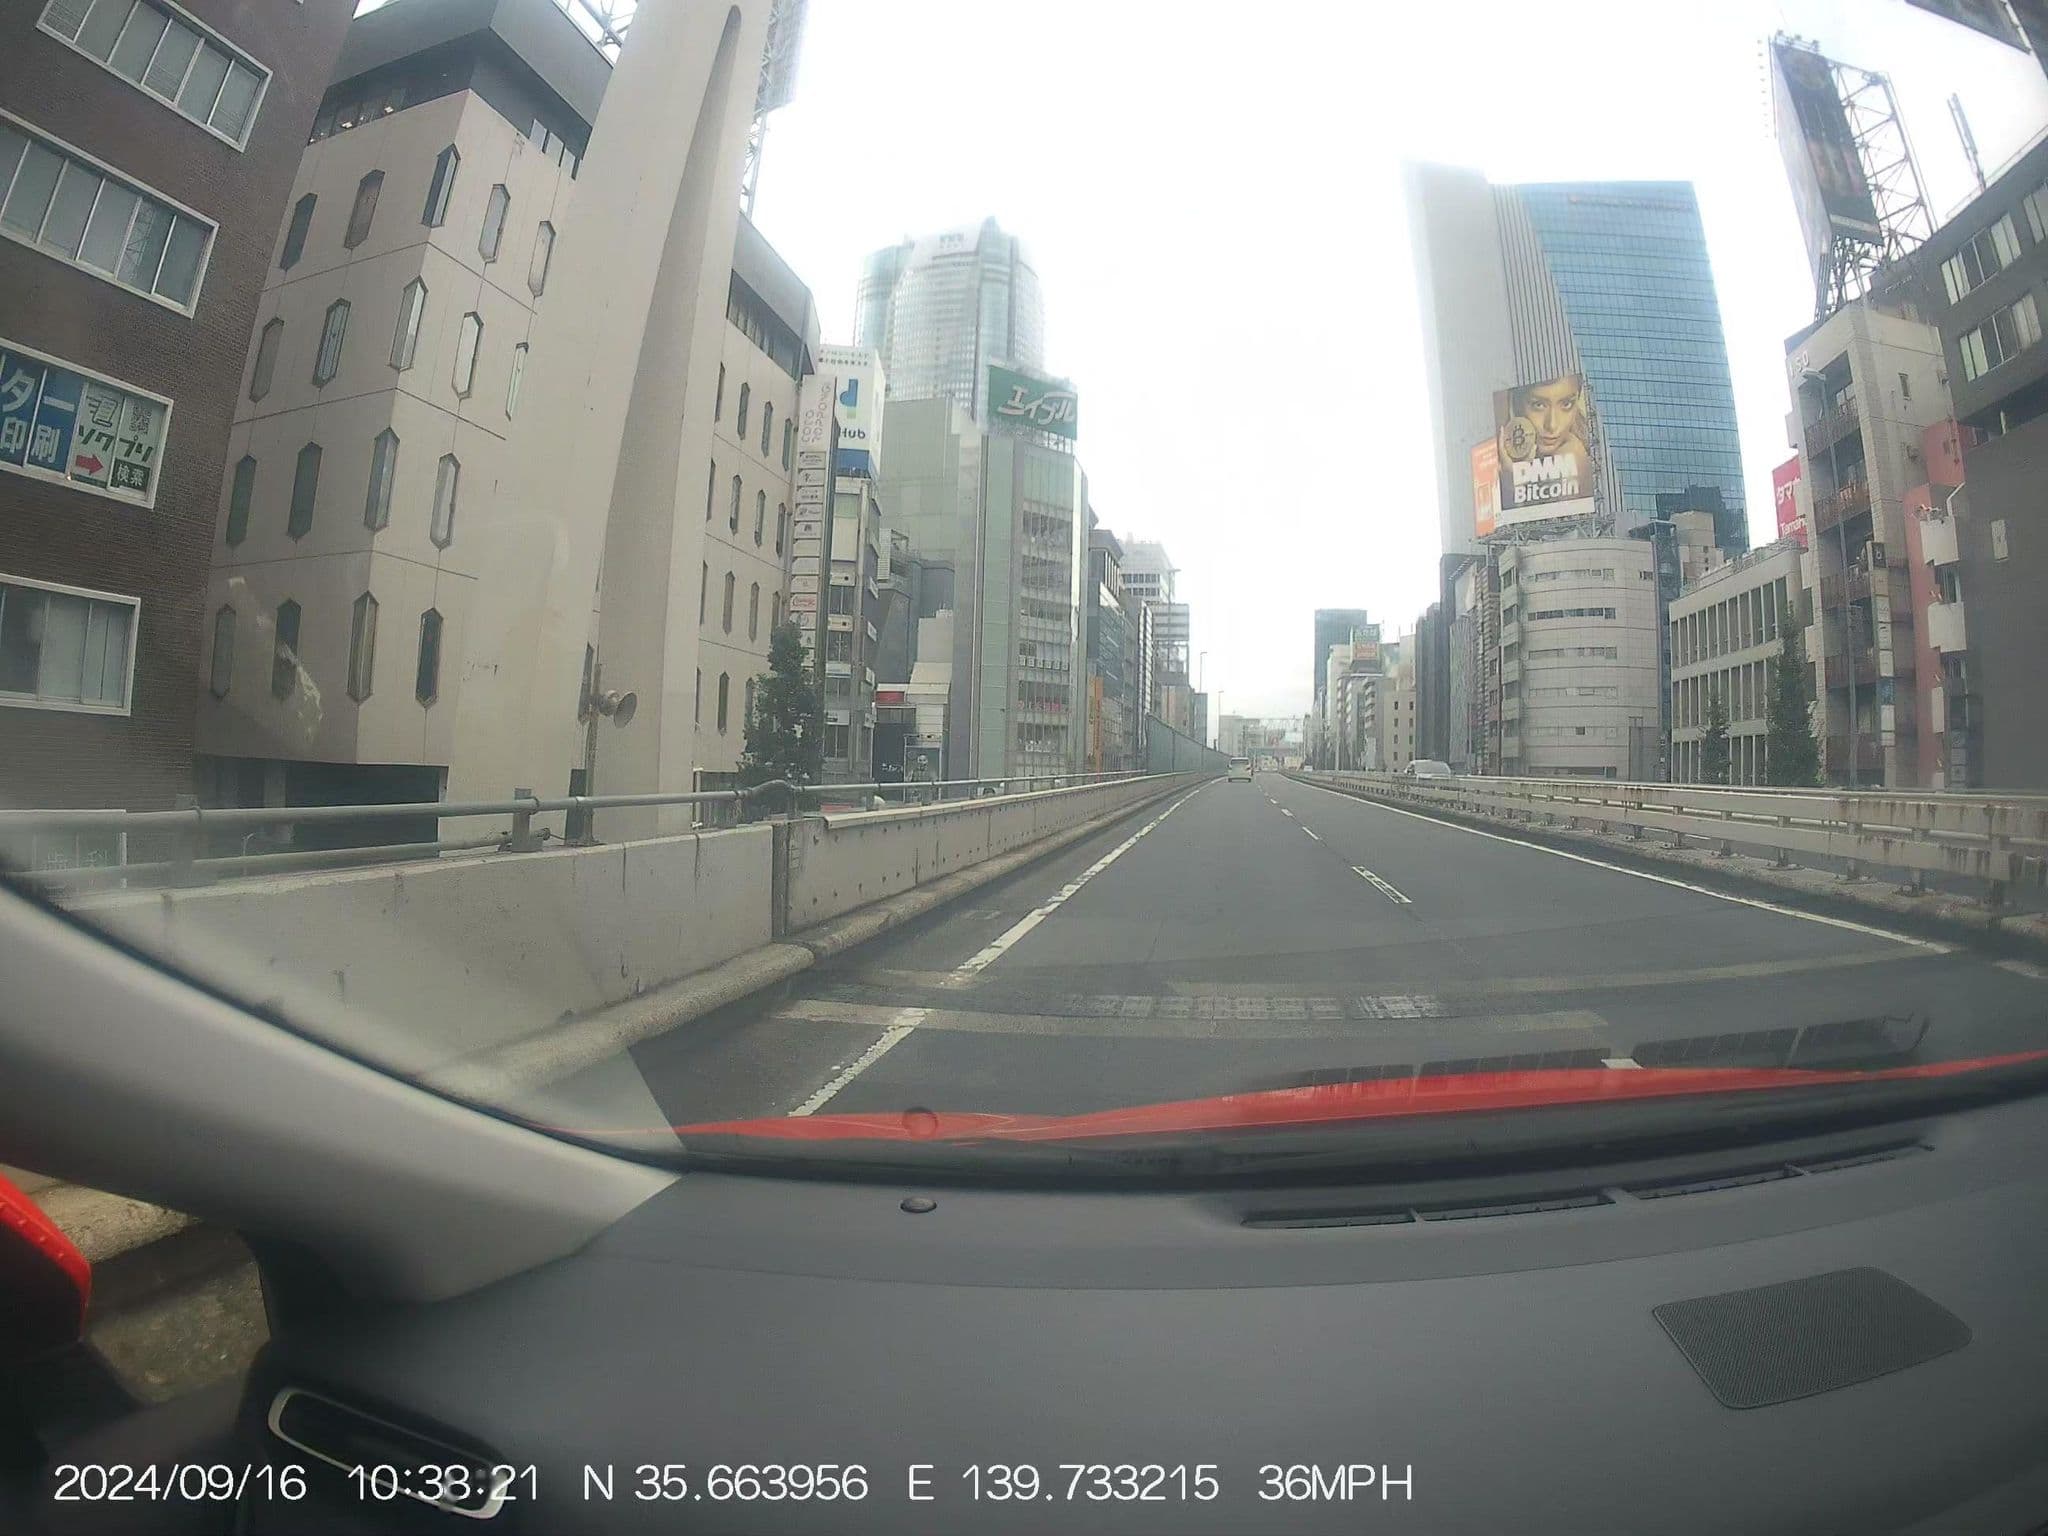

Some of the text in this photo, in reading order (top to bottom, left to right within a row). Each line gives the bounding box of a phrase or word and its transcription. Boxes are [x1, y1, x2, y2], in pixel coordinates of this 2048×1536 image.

[997, 384, 1077, 425] エイブル
[0, 416, 61, 463] 印刷
[116, 463, 145, 487] 検索
[1512, 453, 1578, 484] DMM
[1514, 479, 1580, 504] Bitcoin
